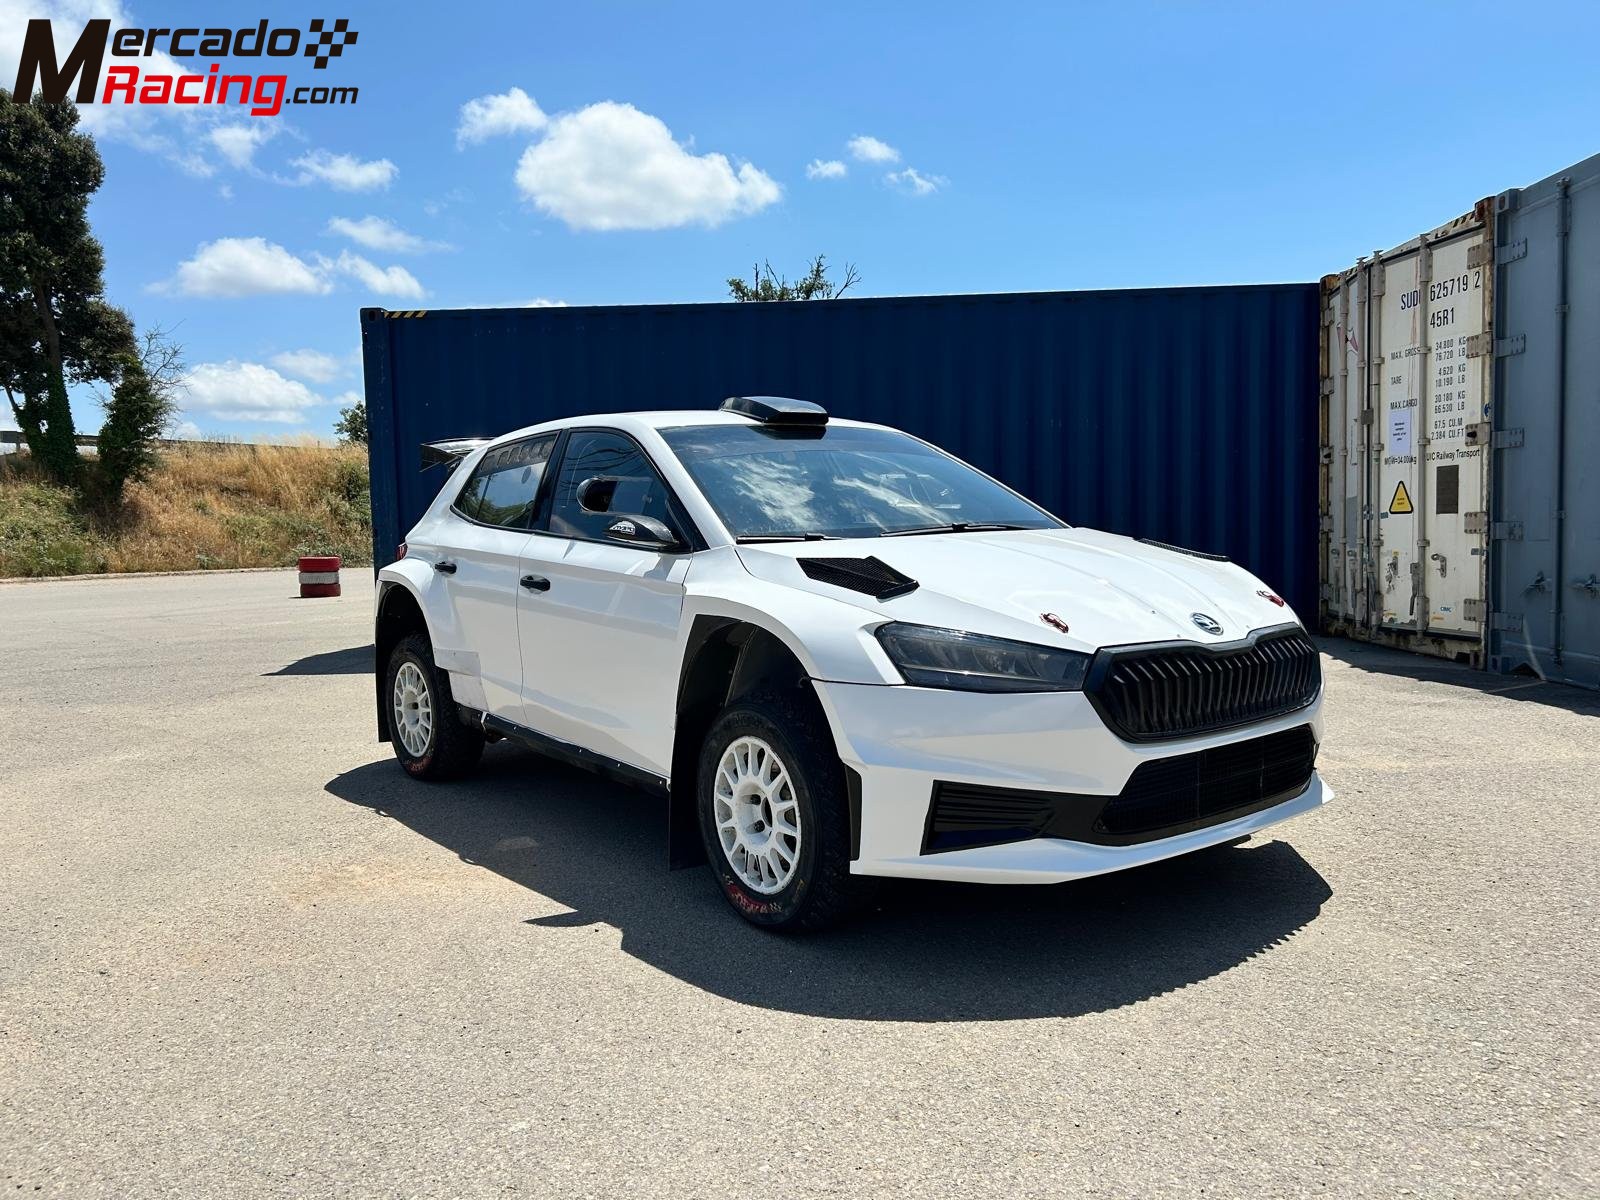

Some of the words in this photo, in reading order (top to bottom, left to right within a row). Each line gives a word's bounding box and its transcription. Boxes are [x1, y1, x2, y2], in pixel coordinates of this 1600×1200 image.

[1430, 274, 1468, 301] 625719
[1474, 271, 1480, 289] 2
[1430, 307, 1455, 328] 45R1
[1458, 336, 1466, 346] KG
[1458, 347, 1466, 357] LB
[1390, 375, 1402, 385] TARE
[1458, 363, 1466, 373] KG
[1457, 374, 1466, 384] LB
[1457, 390, 1466, 400] KG
[1457, 401, 1465, 411] LB
[1436, 451, 1456, 461] Railway
[1456, 448, 1480, 459] Transport
